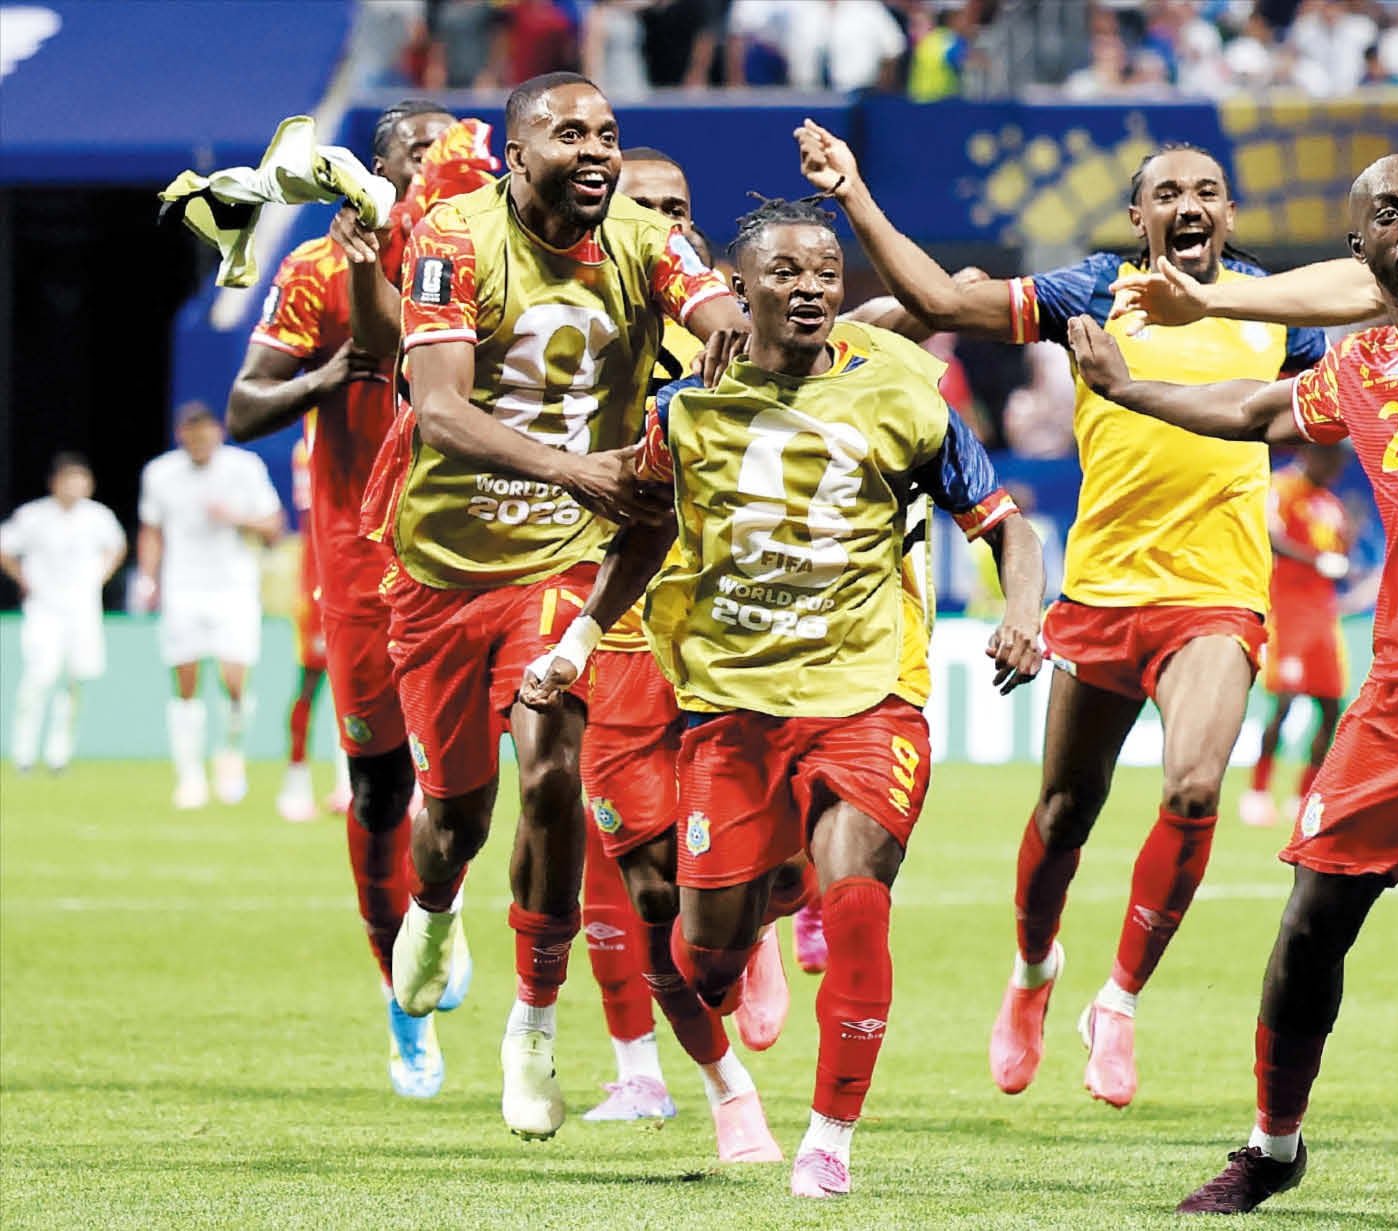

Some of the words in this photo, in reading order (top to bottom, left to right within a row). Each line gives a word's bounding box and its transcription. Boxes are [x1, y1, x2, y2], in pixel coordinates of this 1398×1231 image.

[475, 474, 549, 498] WORLD
[467, 495, 580, 525] 2026
[761, 550, 813, 573] FIFA
[718, 575, 792, 606] WORLD
[795, 594, 835, 612] CUP
[711, 596, 828, 640] 2026
[891, 735, 920, 793] 9
